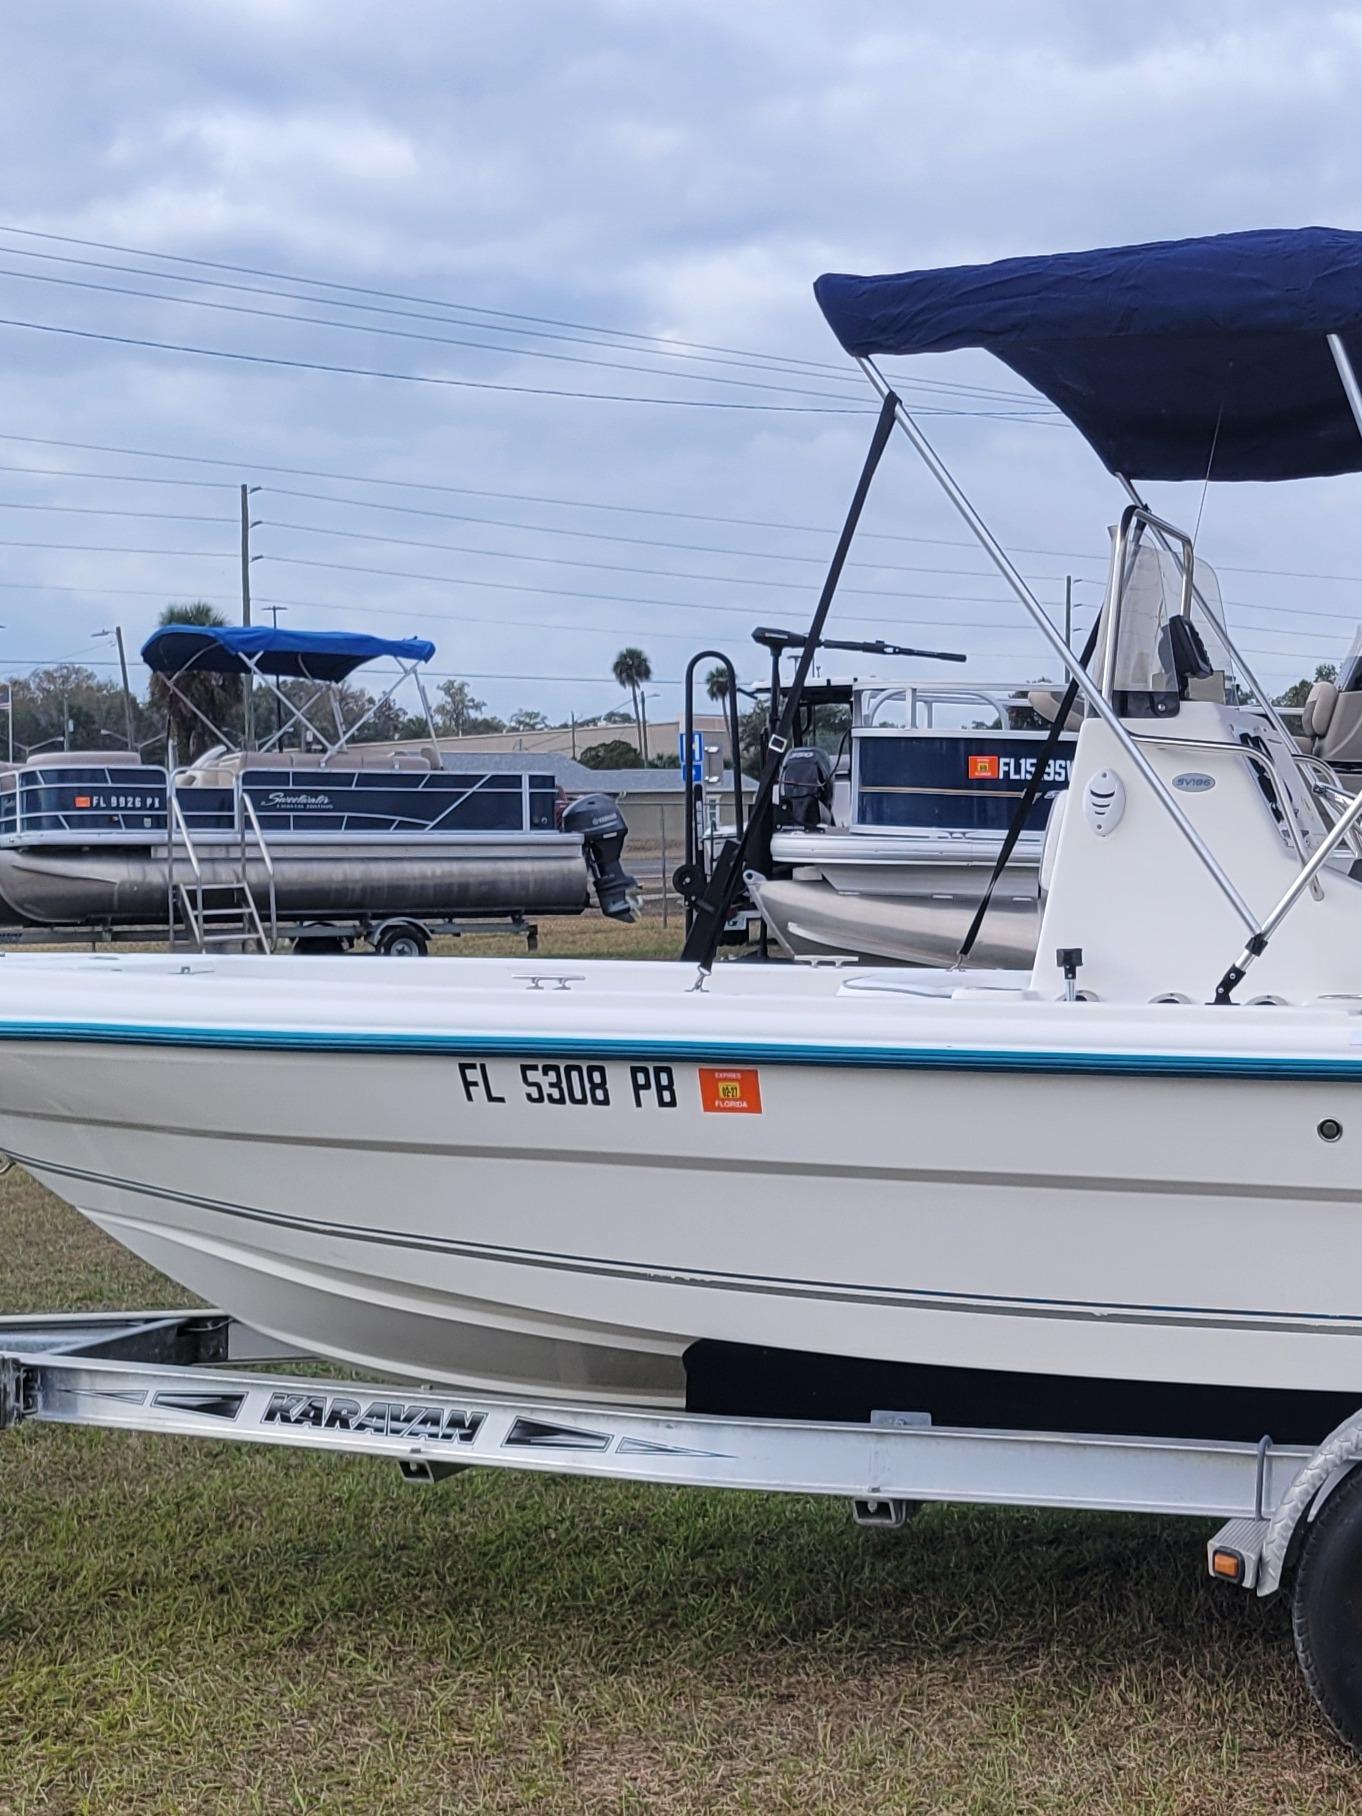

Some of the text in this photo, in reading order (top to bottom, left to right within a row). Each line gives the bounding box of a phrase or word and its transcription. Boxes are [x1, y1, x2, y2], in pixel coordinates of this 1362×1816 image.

[998, 757, 1075, 782] FL159S
[92, 796, 107, 808] FL
[457, 1062, 678, 1109] FL 5308 PB
[714, 1100, 749, 1109] FLORIDA
[259, 1391, 490, 1446] KARAVAN
